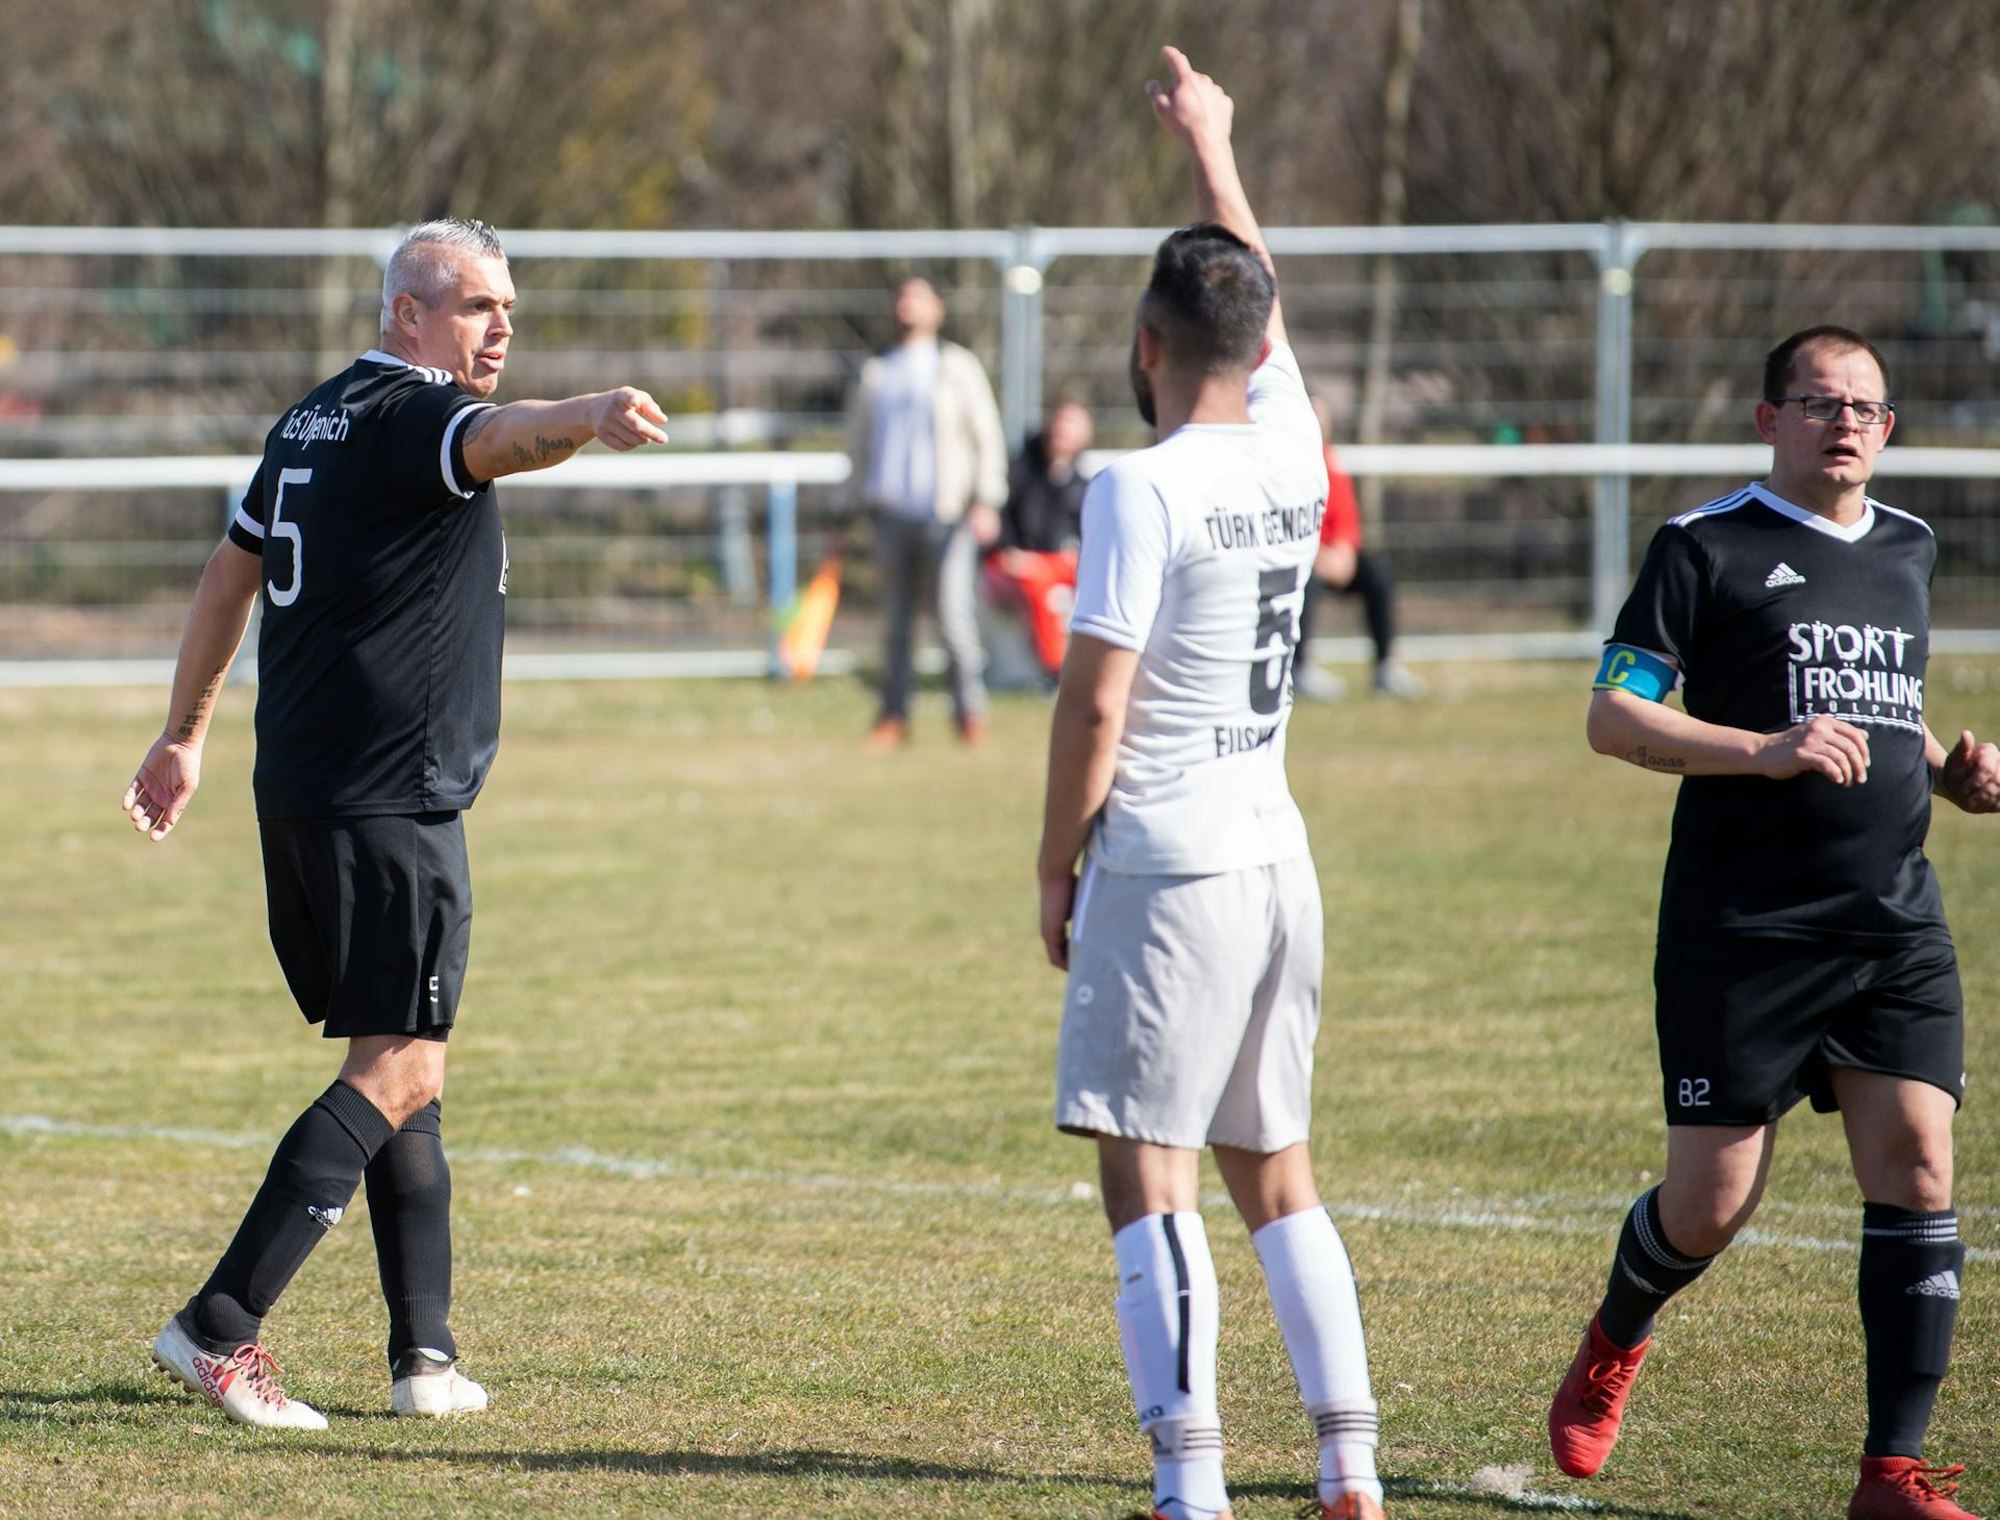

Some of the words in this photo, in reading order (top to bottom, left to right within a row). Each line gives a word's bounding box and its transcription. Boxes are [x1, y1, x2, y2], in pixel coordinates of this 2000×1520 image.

[267, 468, 313, 607] 5
[1204, 506, 1260, 551] TÜRK
[1765, 575, 1806, 588] adidas
[1606, 649, 1636, 684] C
[1788, 620, 1916, 668] SPORT
[1804, 661, 1923, 711] FRÖHLING
[1679, 1078, 1711, 1107] 82
[192, 1357, 225, 1408] adidas
